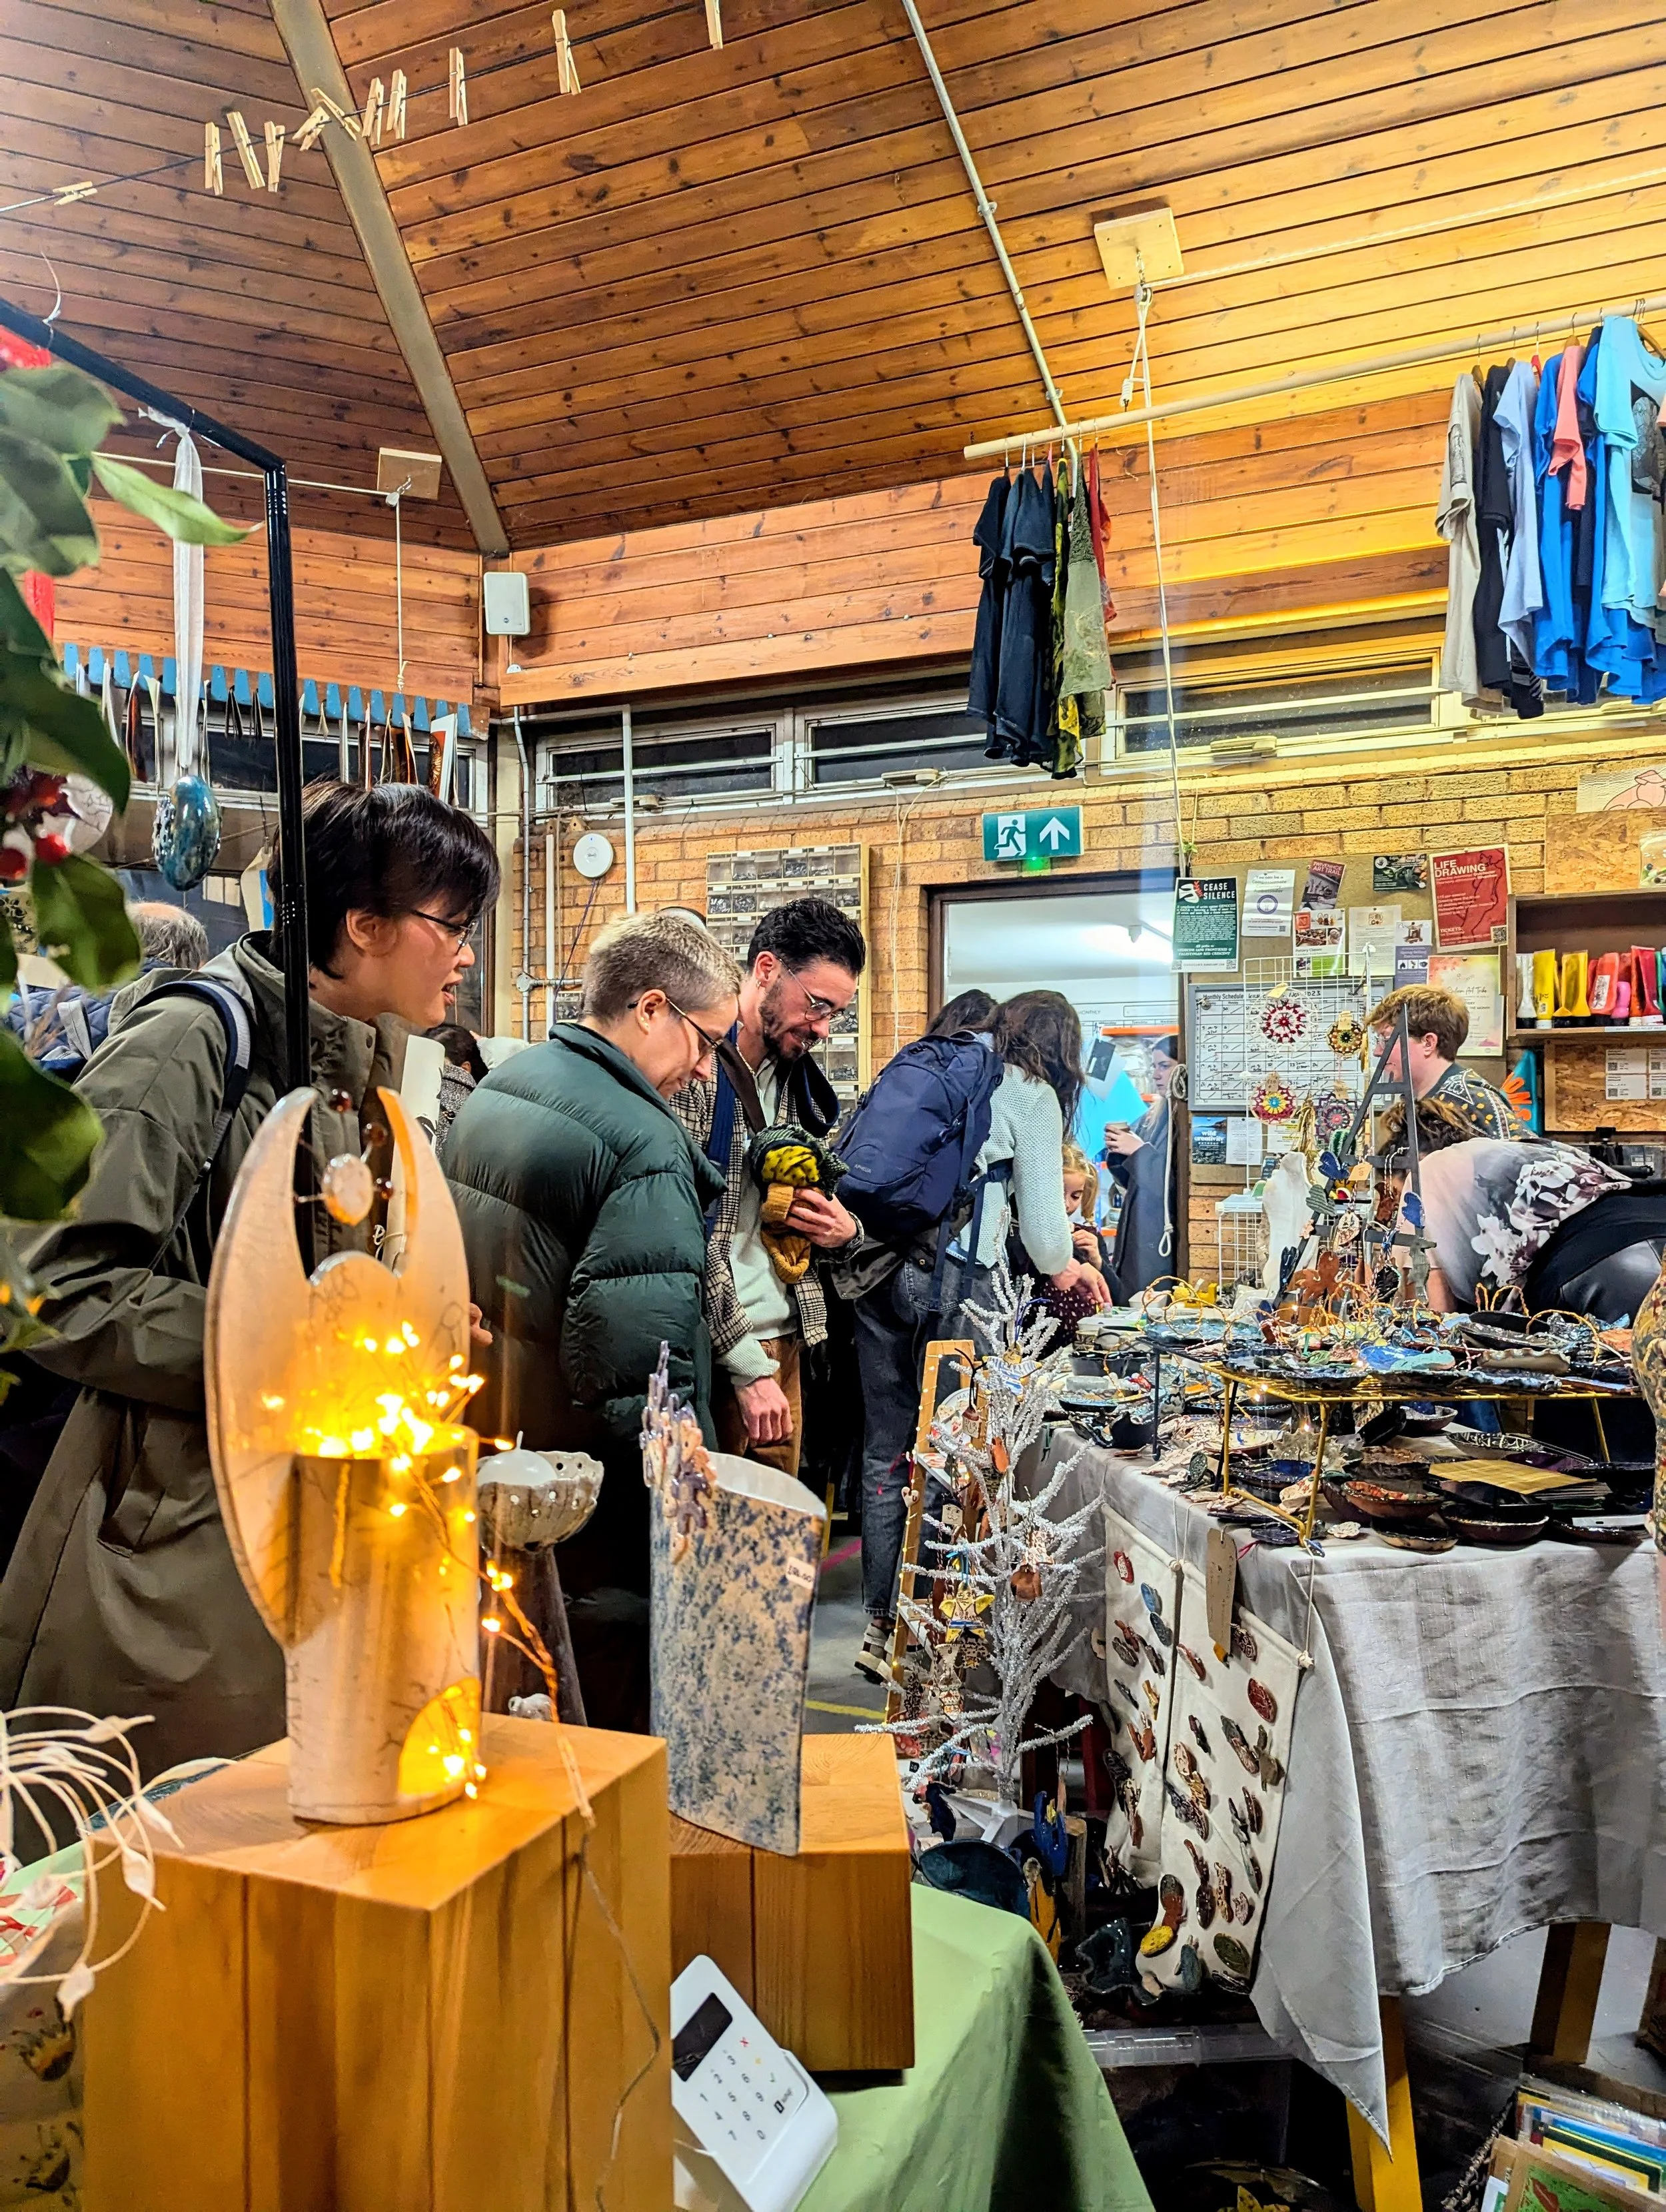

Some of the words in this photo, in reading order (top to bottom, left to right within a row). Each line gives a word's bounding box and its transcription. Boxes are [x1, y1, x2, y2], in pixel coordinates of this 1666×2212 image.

[1433, 859, 1457, 870] LIFE
[1435, 863, 1486, 877] DRAWING
[1204, 883, 1228, 891] CEASE
[1203, 891, 1236, 899] SILENCE
[700, 2093, 708, 2102] 1
[714, 2073, 722, 2084] 2
[727, 2055, 736, 2065] 3
[728, 2091, 737, 2102] 5
[741, 2073, 750, 2083] 6
[742, 2111, 751, 2121] 8
[755, 2091, 764, 2102] 9
[756, 2129, 766, 2140] 0
